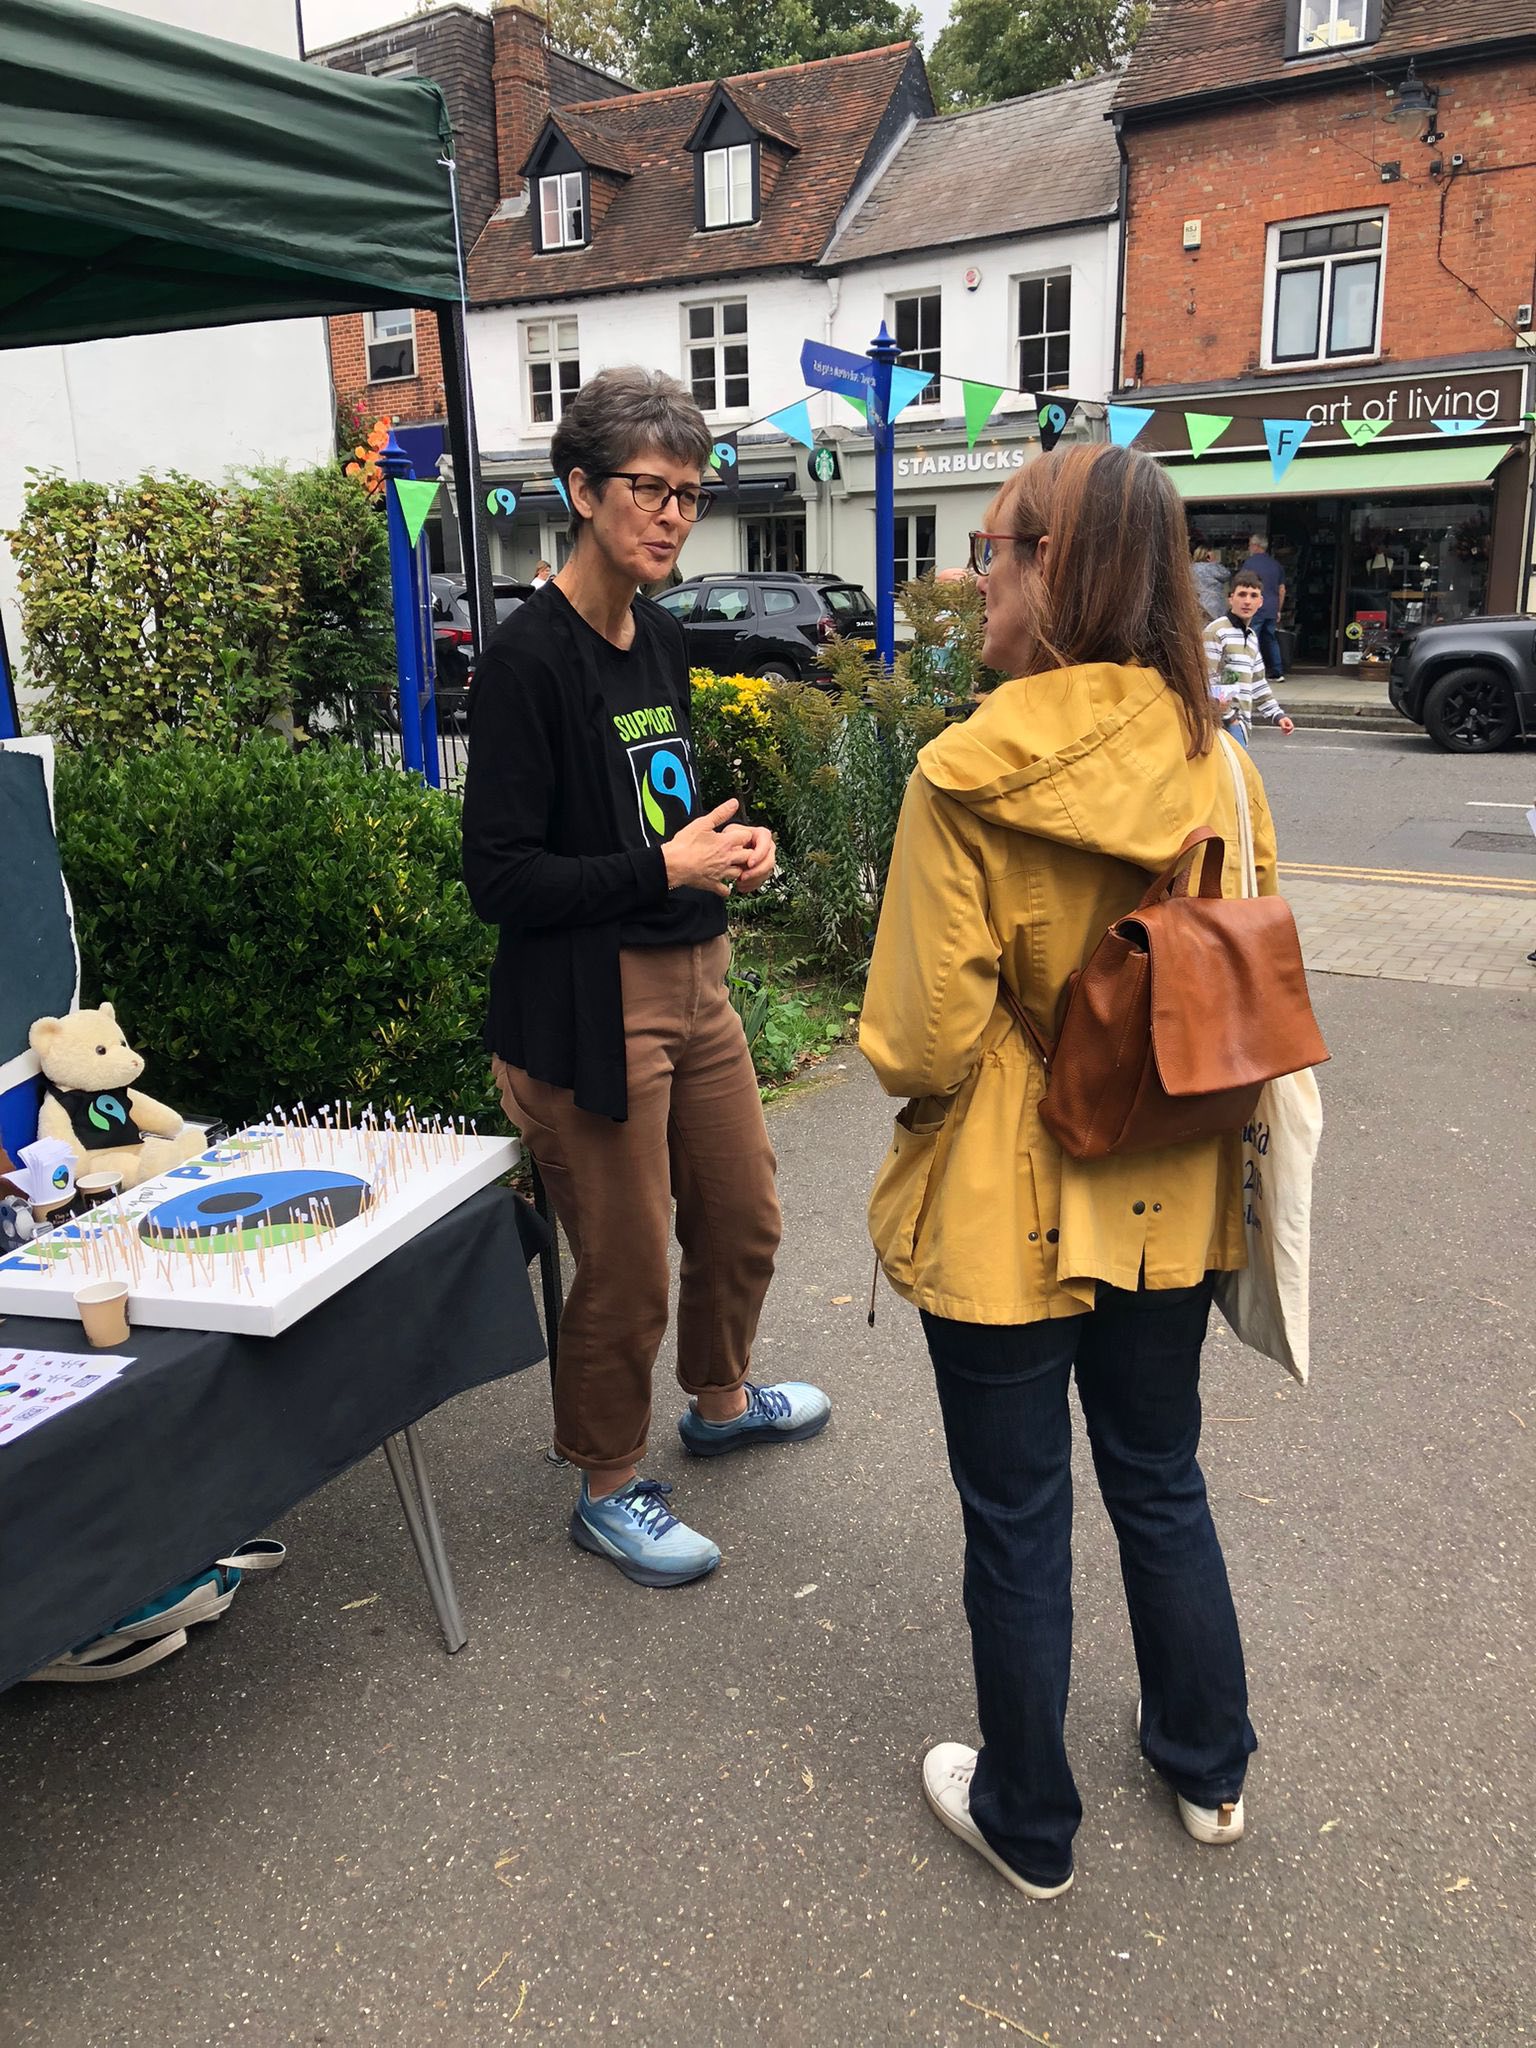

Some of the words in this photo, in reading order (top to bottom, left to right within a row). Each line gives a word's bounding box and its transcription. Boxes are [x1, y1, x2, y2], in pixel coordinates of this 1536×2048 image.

[1306, 395, 1352, 427] art
[1362, 390, 1398, 421] of
[1408, 385, 1500, 420] living
[1276, 429, 1294, 455] F
[897, 449, 1025, 476] STARBUCKS
